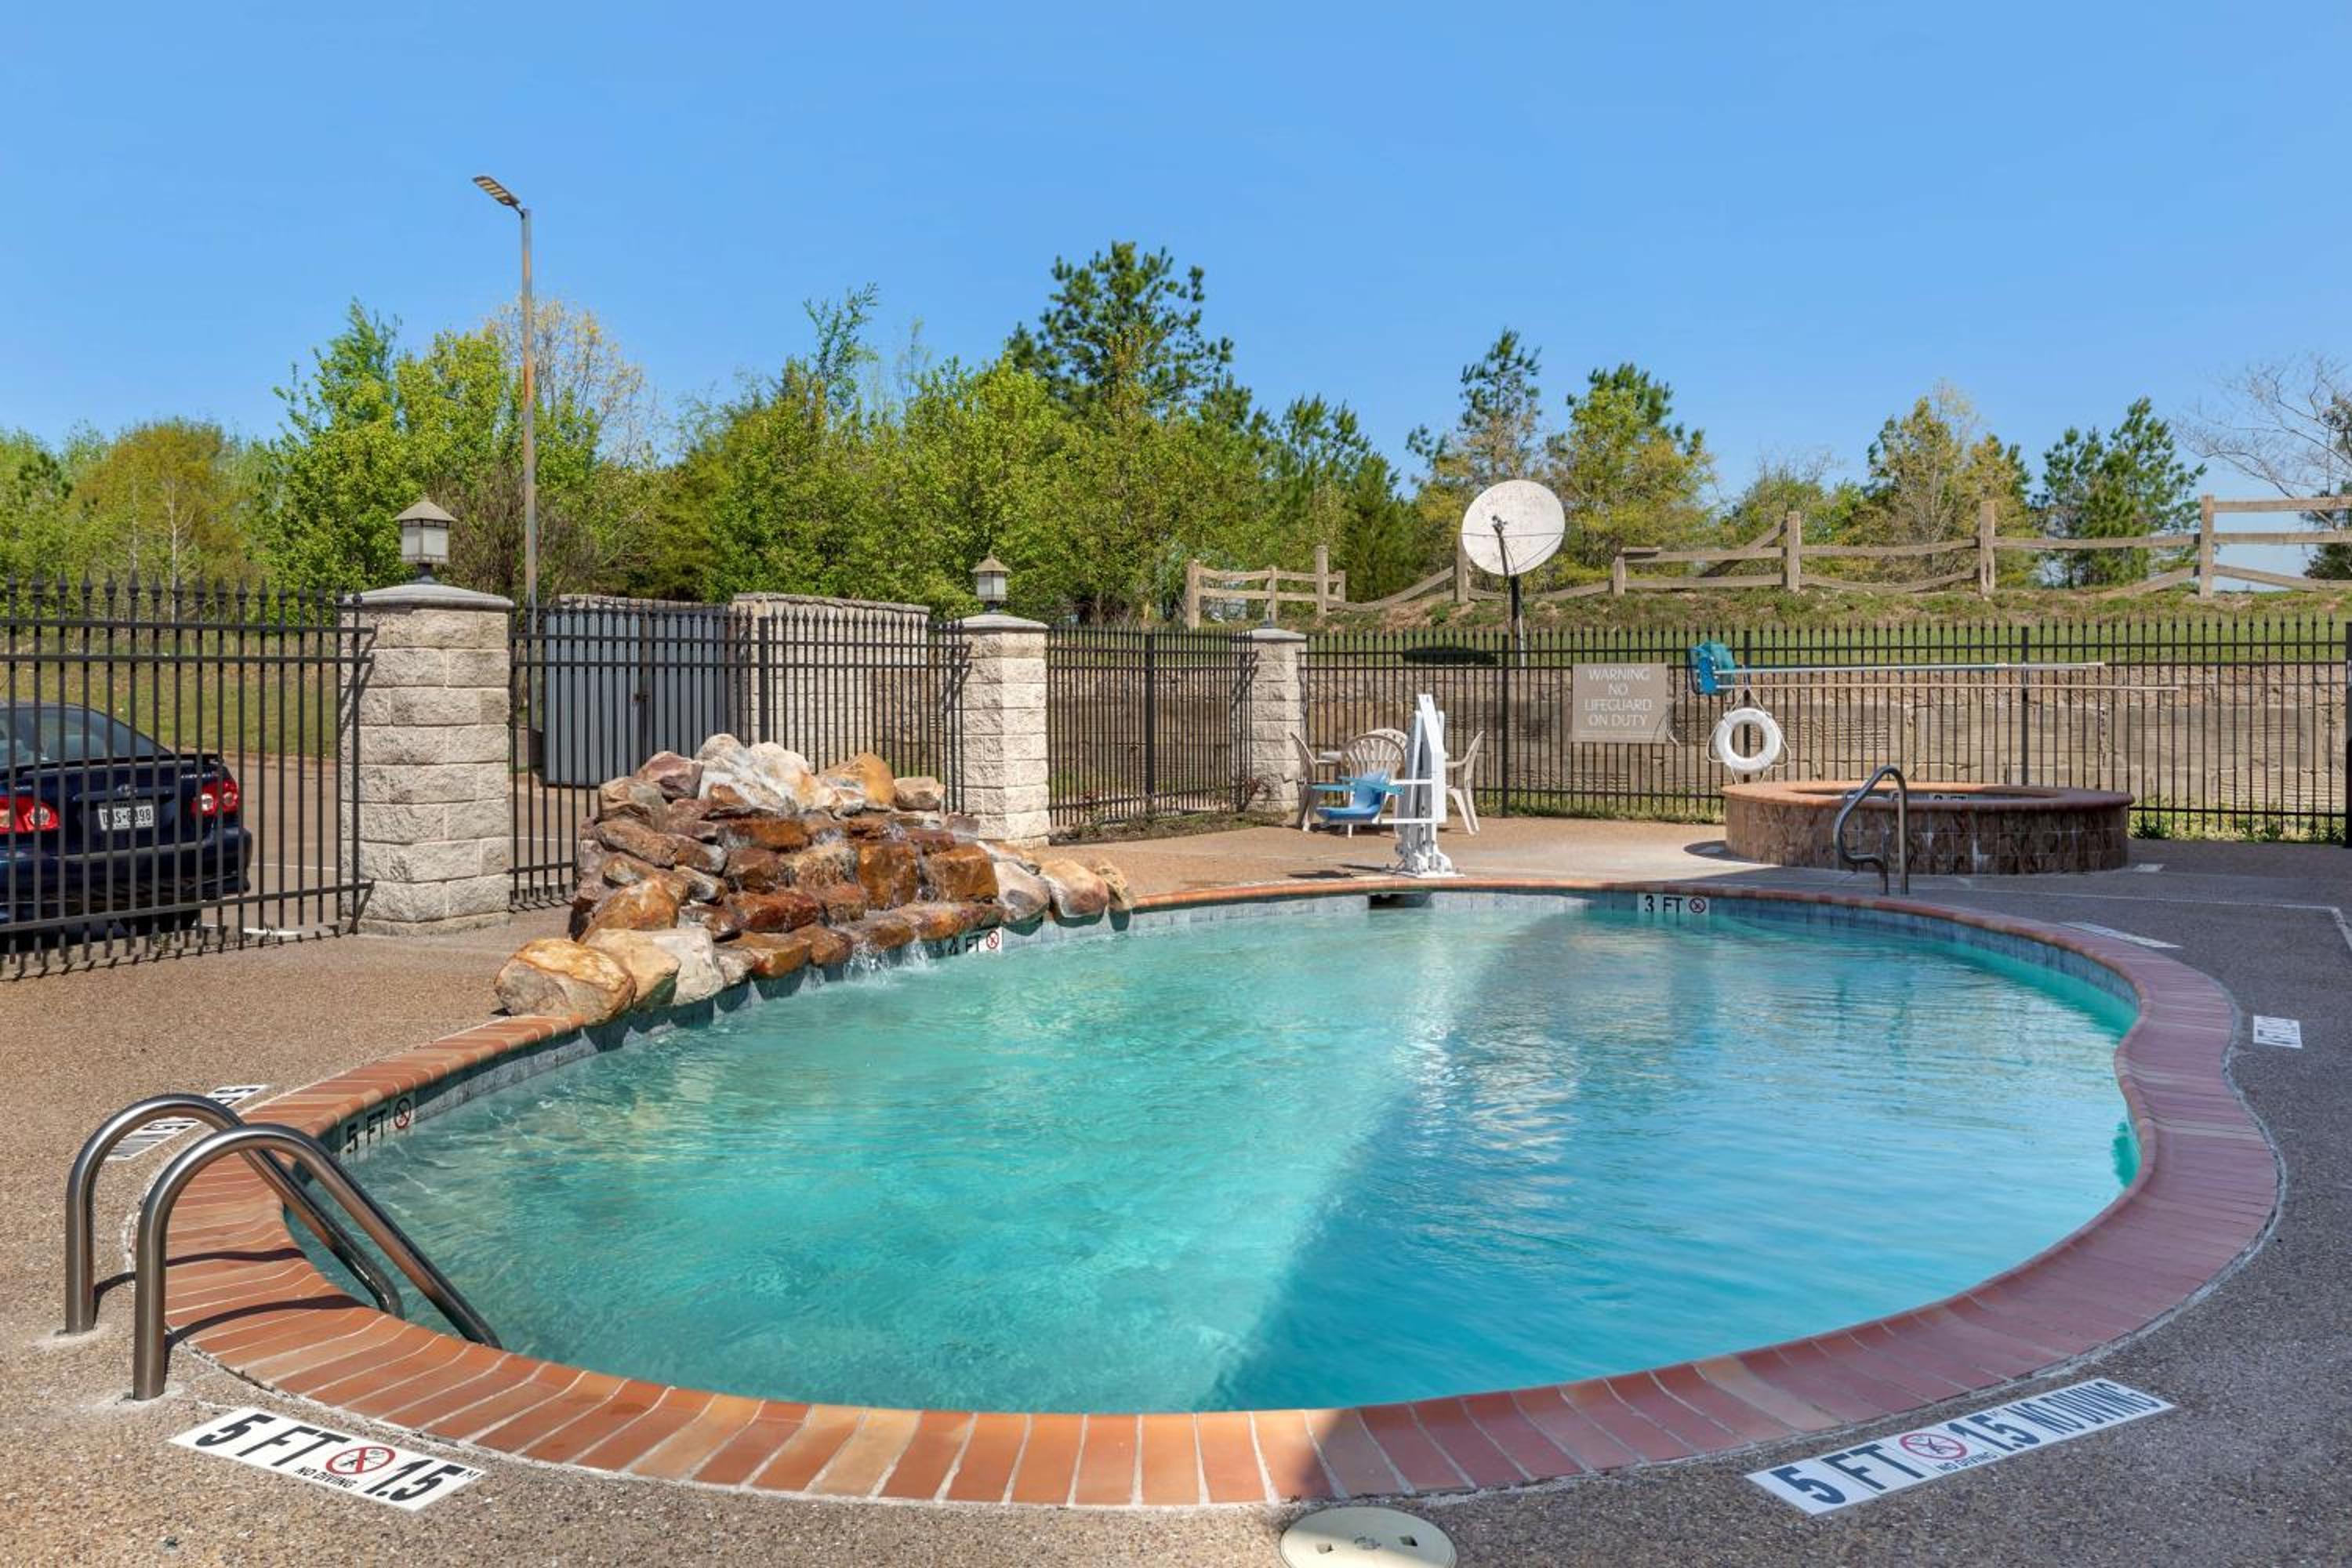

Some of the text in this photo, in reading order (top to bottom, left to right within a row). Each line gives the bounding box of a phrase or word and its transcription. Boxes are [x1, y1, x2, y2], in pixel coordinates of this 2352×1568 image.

[1589, 668, 1650, 681] WARNING
[1608, 683, 1629, 695] NO
[1584, 699, 1652, 711] LIFEGUARD
[1588, 714, 1647, 727] ON DUTY
[1645, 895, 1683, 913] 3 FT
[965, 934, 982, 953] FT
[346, 1109, 387, 1154] 5 FT
[195, 1414, 277, 1447] 5
[235, 1425, 352, 1467] FT
[1769, 1381, 2161, 1505] 5 FT 1.5 NO DIVING
[294, 1466, 359, 1489] NO DIVING
